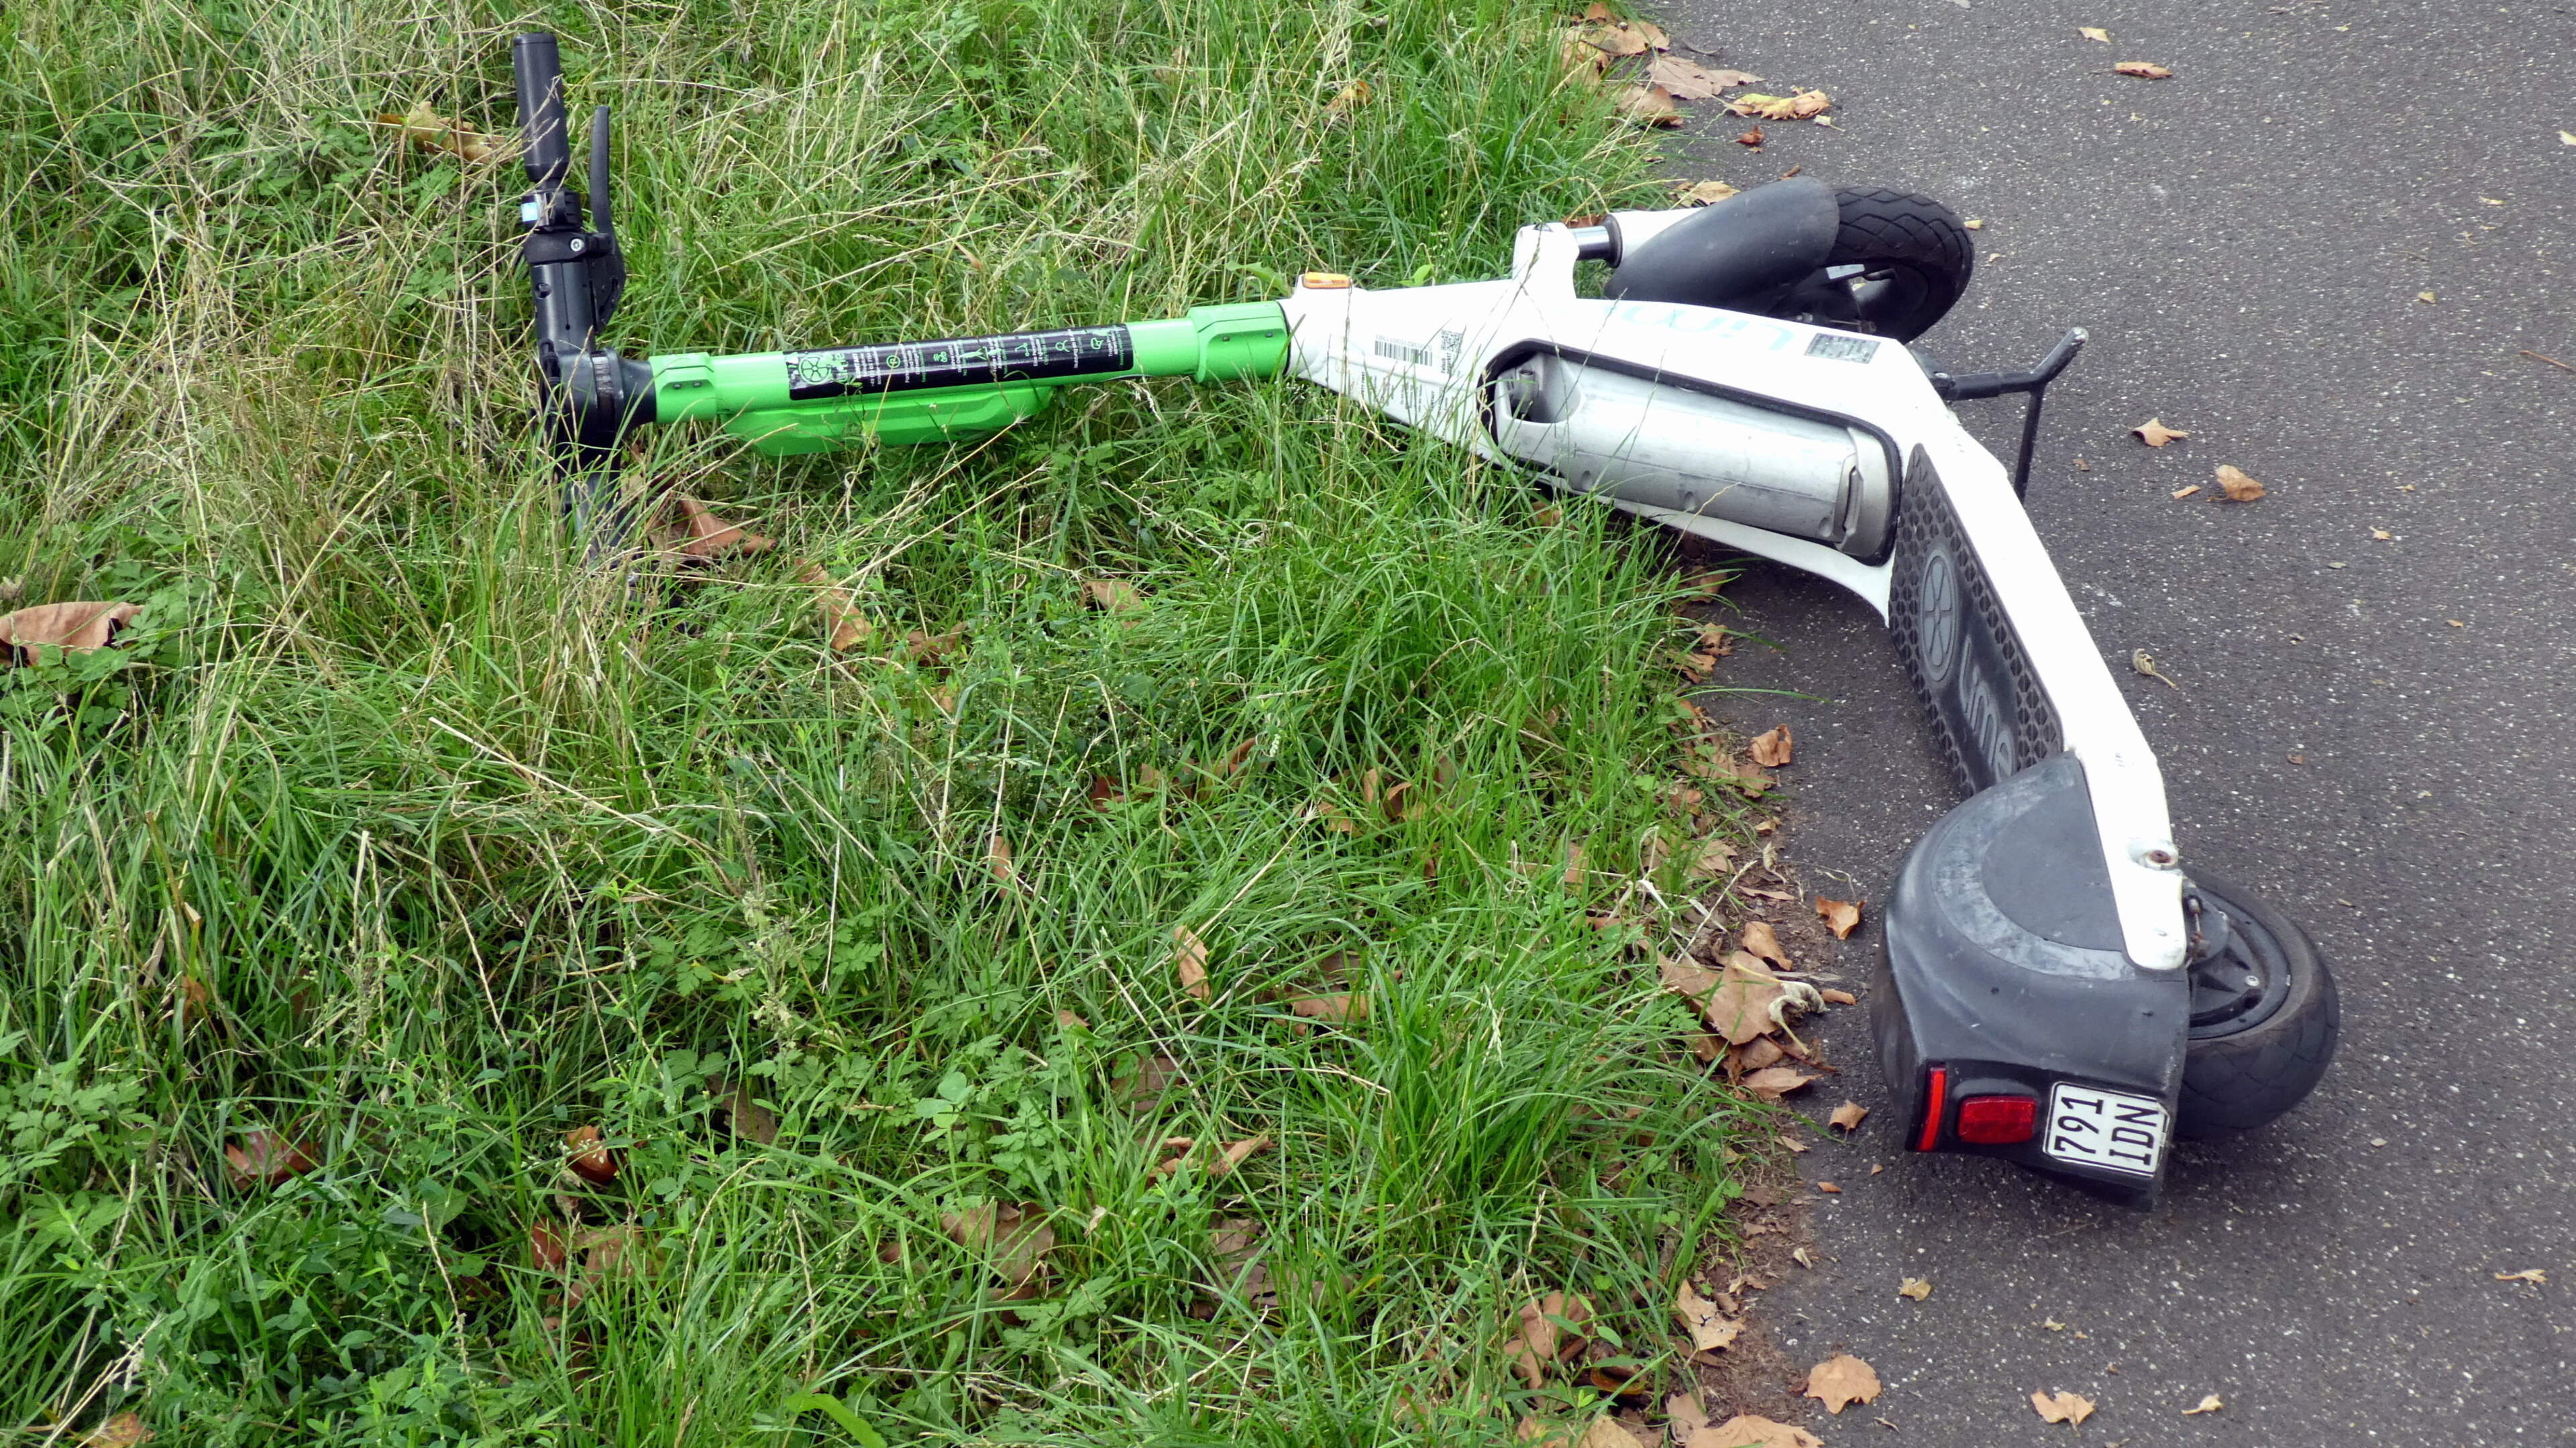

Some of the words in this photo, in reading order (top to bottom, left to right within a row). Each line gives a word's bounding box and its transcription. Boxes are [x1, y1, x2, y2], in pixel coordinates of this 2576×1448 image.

[1603, 305, 1795, 351] Lim
[1958, 634, 2015, 782] Lime
[2053, 1097, 2104, 1154] 791
[2108, 1103, 2159, 1166] IDN
